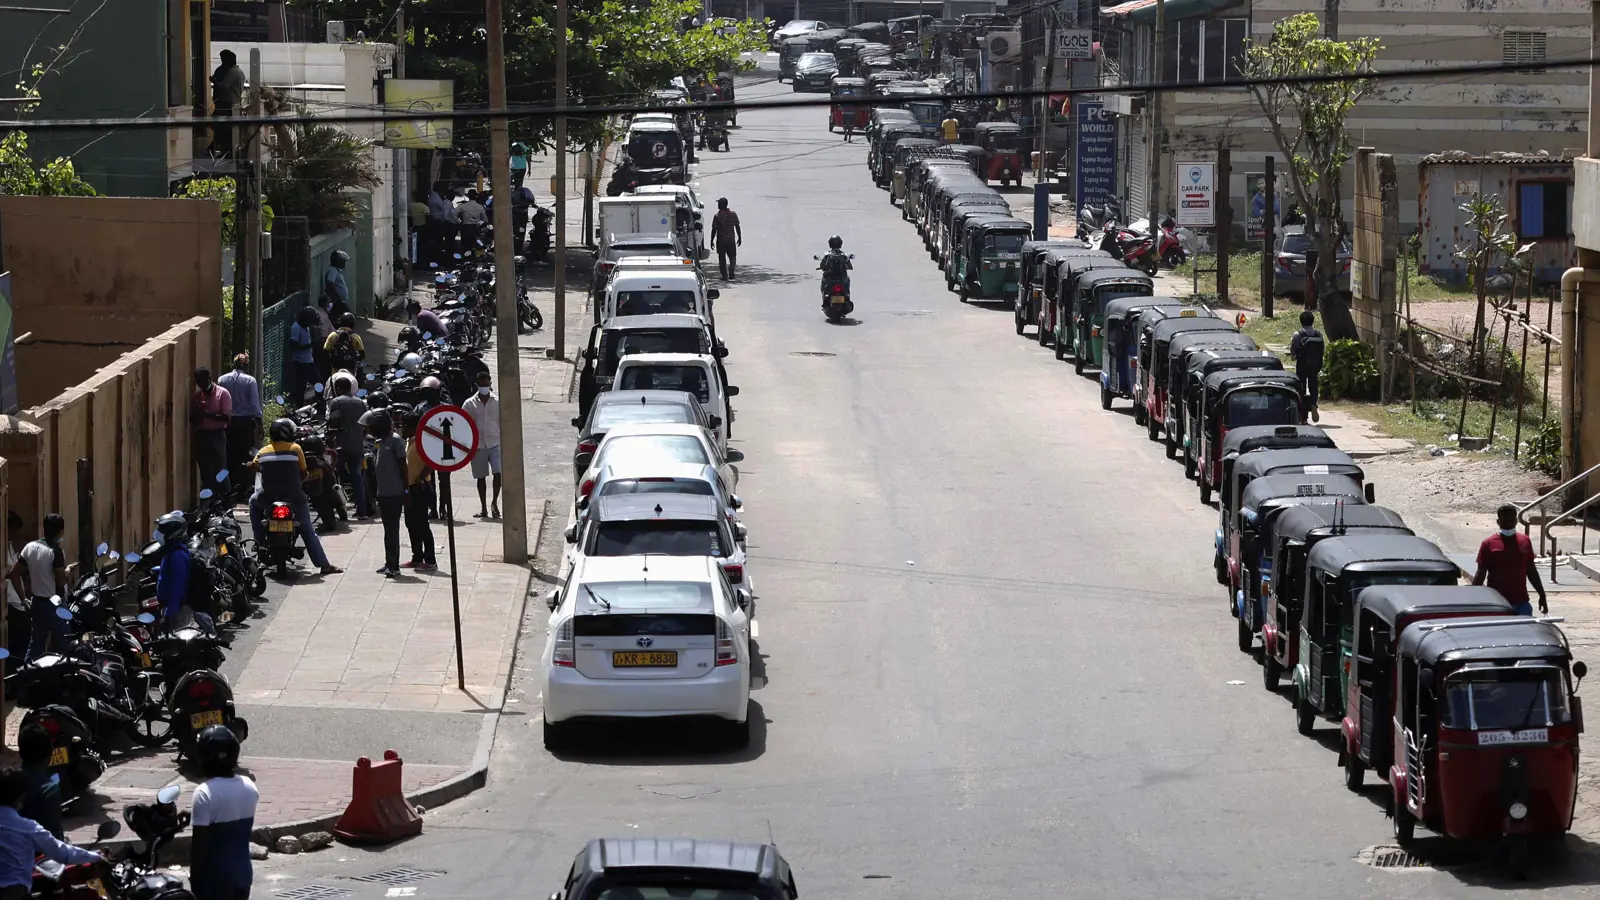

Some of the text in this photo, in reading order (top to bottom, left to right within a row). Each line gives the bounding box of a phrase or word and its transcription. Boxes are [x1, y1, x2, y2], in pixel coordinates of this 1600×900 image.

[1060, 33, 1089, 47] roots
[1087, 107, 1109, 121] PC
[1081, 124, 1115, 133] WORLD
[1087, 146, 1107, 154] Keyboard
[1081, 156, 1096, 164] Laptop
[1081, 166, 1096, 174] Laptop
[1084, 176, 1099, 184] Laptop
[1315, 484, 1325, 494] TAXI
[624, 652, 638, 664] KR
[650, 652, 675, 664] 6838
